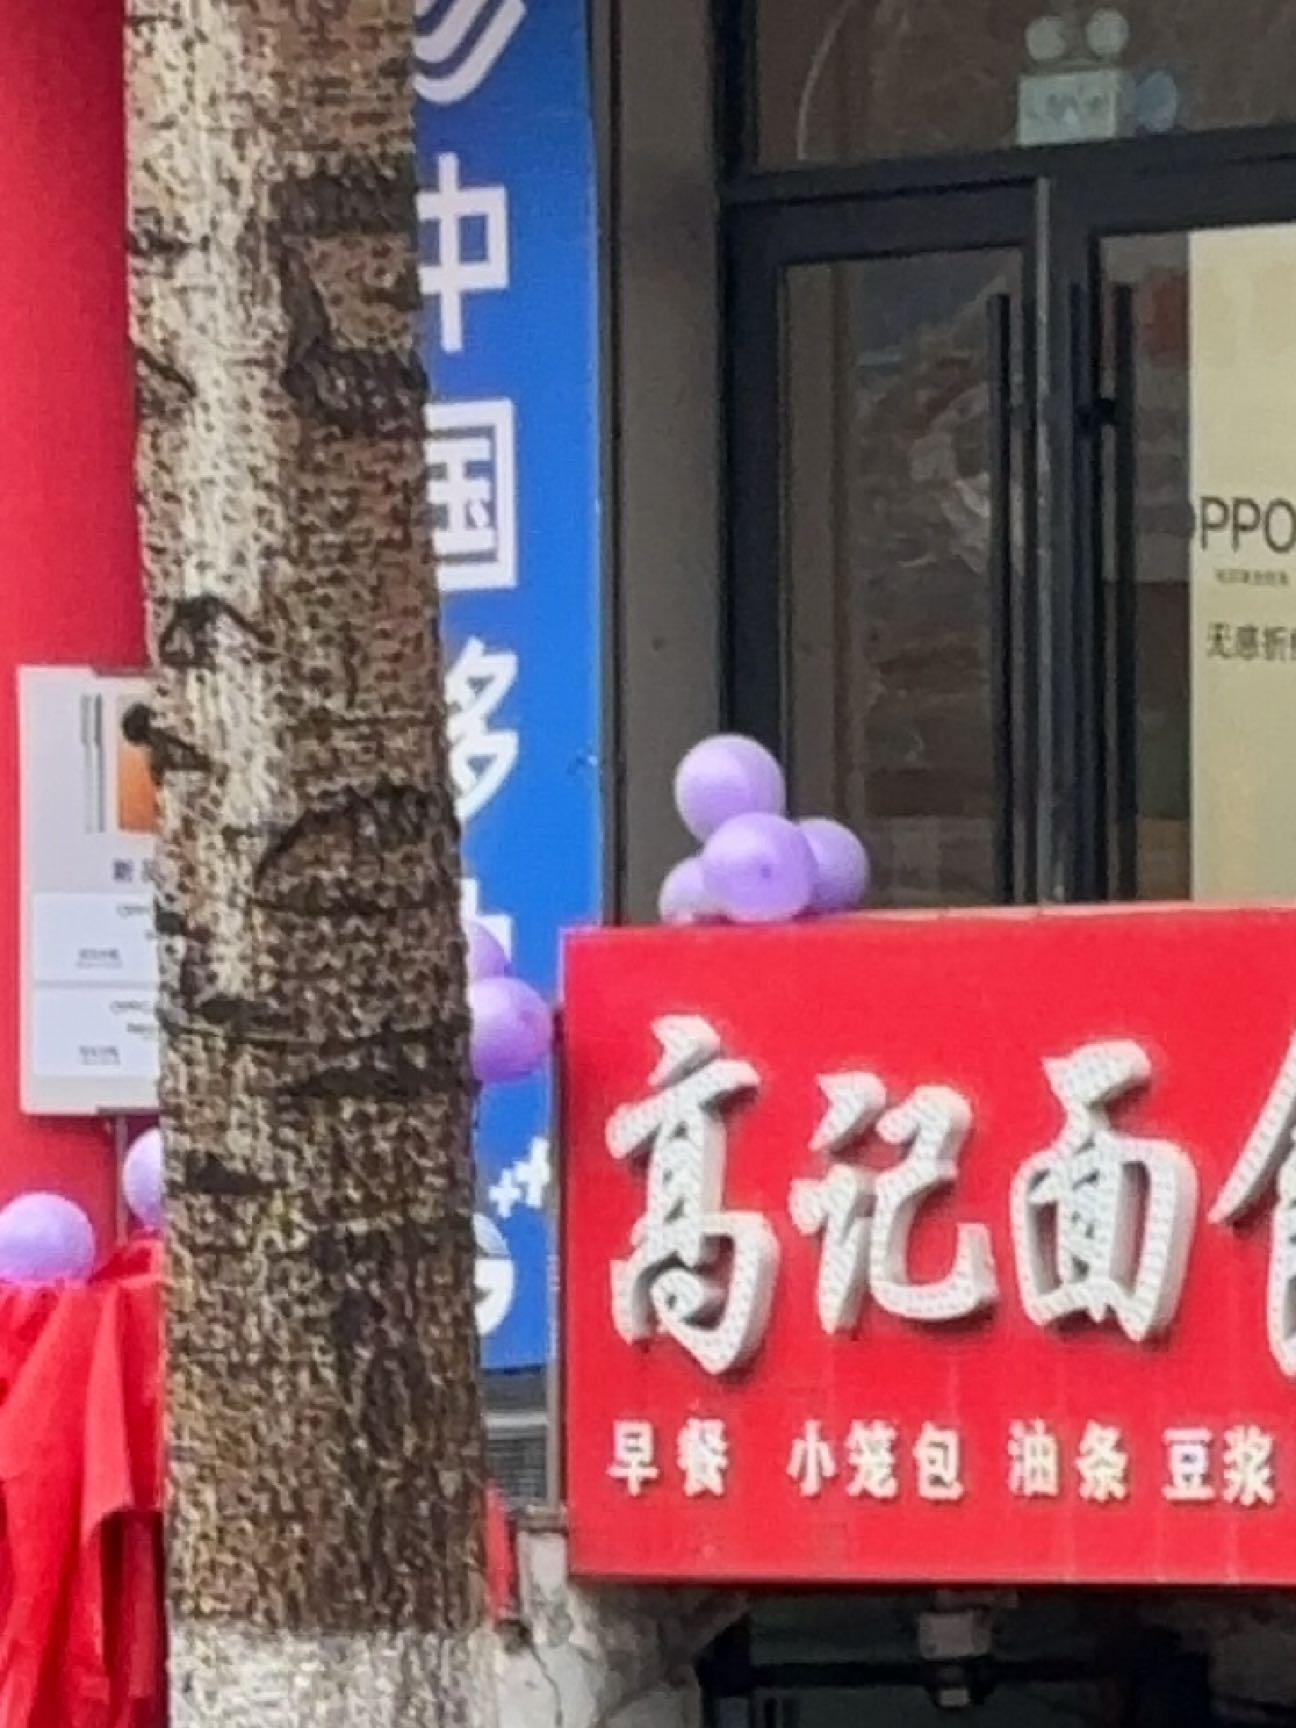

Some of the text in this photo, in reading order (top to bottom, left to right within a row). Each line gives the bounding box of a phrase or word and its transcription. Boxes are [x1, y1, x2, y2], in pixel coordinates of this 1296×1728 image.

[606, 1417, 730, 1498] 早餐
[785, 1417, 965, 1502] 小笼包
[1007, 1417, 1130, 1503] 油条
[1161, 1424, 1276, 1507] 豆浆
